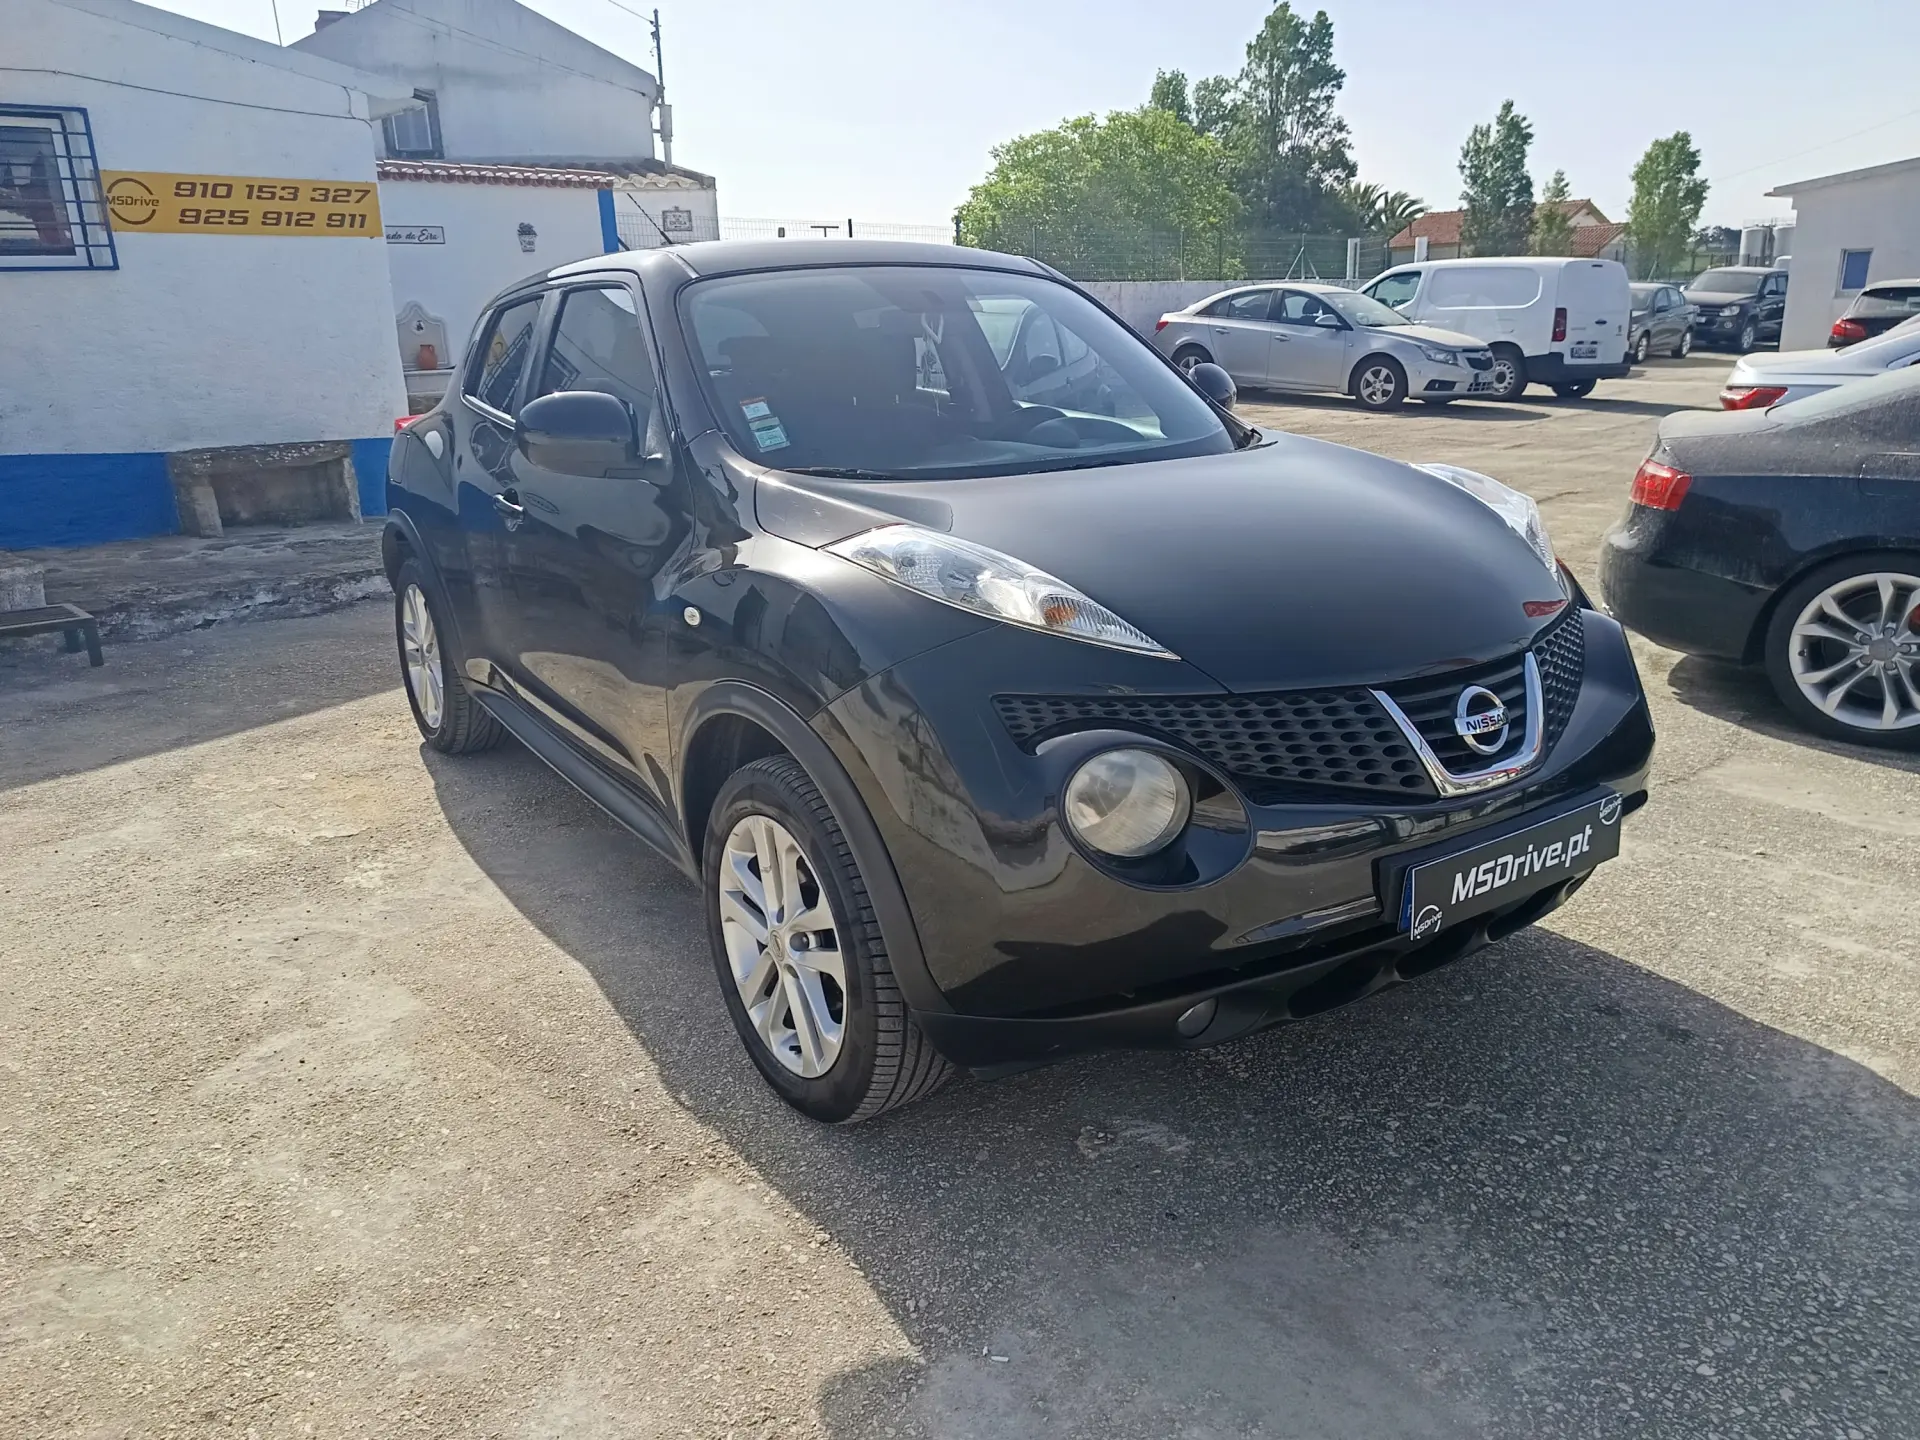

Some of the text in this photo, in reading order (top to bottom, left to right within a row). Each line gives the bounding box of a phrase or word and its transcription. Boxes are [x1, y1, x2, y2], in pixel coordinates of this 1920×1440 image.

[106, 194, 160, 207] MSDrive
[174, 181, 371, 204] 910 153 327
[178, 208, 368, 229] 925 912 911
[1450, 824, 1593, 905] MSDrive.pt
[1413, 911, 1443, 937] MSDrive
